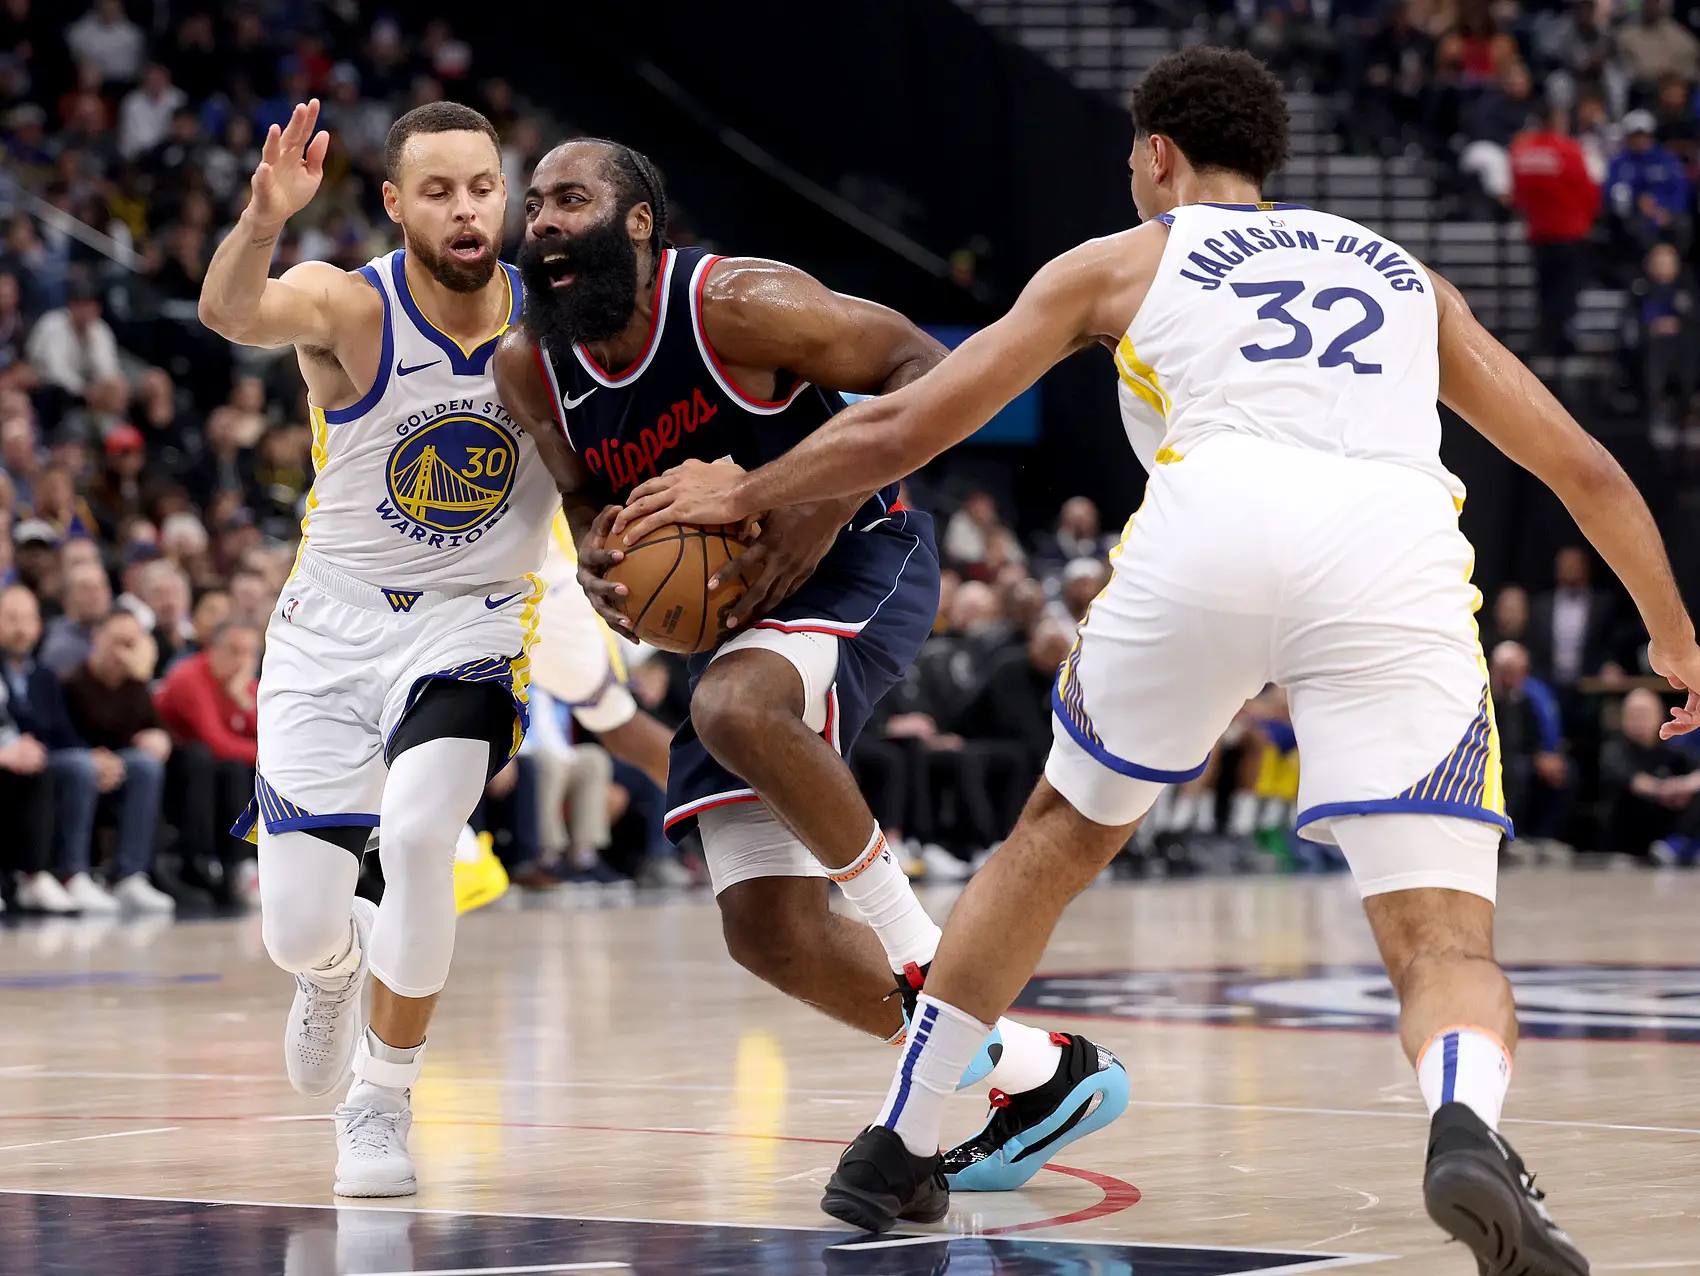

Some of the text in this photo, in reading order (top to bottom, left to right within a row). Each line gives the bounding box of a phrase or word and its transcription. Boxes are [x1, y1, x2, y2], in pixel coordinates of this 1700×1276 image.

[1180, 227, 1424, 294] JACKSON-DAVIS
[1229, 280, 1385, 374] 32
[396, 399, 474, 436] GOLDEN
[585, 387, 718, 494] Clippers
[461, 446, 507, 479] 30
